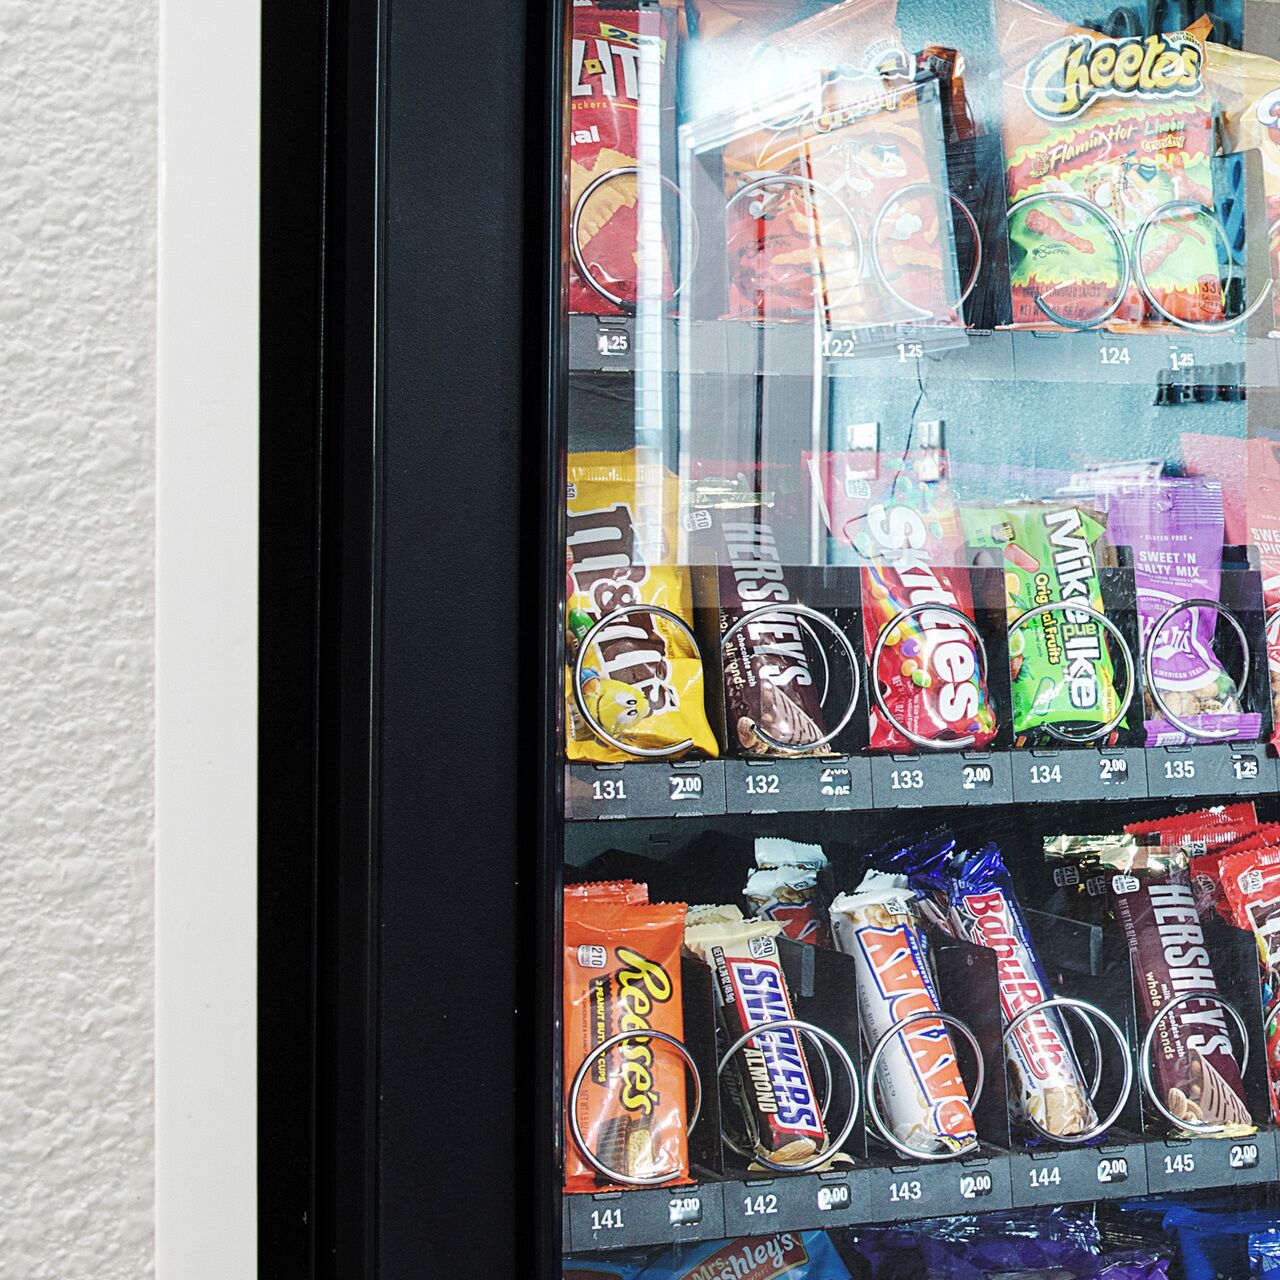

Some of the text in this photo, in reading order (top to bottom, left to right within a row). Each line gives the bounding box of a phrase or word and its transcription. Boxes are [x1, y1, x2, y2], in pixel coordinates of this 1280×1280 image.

[1031, 35, 1201, 113] Cheetos
[821, 340, 855, 358] 122
[1100, 347, 1130, 364] 124
[1140, 552, 1180, 563] SWEET
[1137, 564, 1199, 577] SALTY MIX
[868, 506, 979, 722] Skittles
[1043, 509, 1101, 709] Mike and Ike
[1030, 766, 1062, 783] 134
[1164, 761, 1195, 778] 135
[746, 776, 780, 794] 132
[891, 771, 923, 788] 133
[592, 780, 626, 799] 131
[1148, 885, 1233, 1056] HERSHEY'S
[616, 948, 670, 1114] Reese's
[738, 966, 818, 1130] SNICKERS
[598, 1056, 606, 1082] CUPS
[744, 1048, 778, 1113] ALMOND
[1165, 1154, 1194, 1173] 145
[1030, 1167, 1060, 1187] 144
[890, 1182, 922, 1201] 143
[744, 1196, 778, 1215] 142
[591, 1210, 624, 1230] 141
